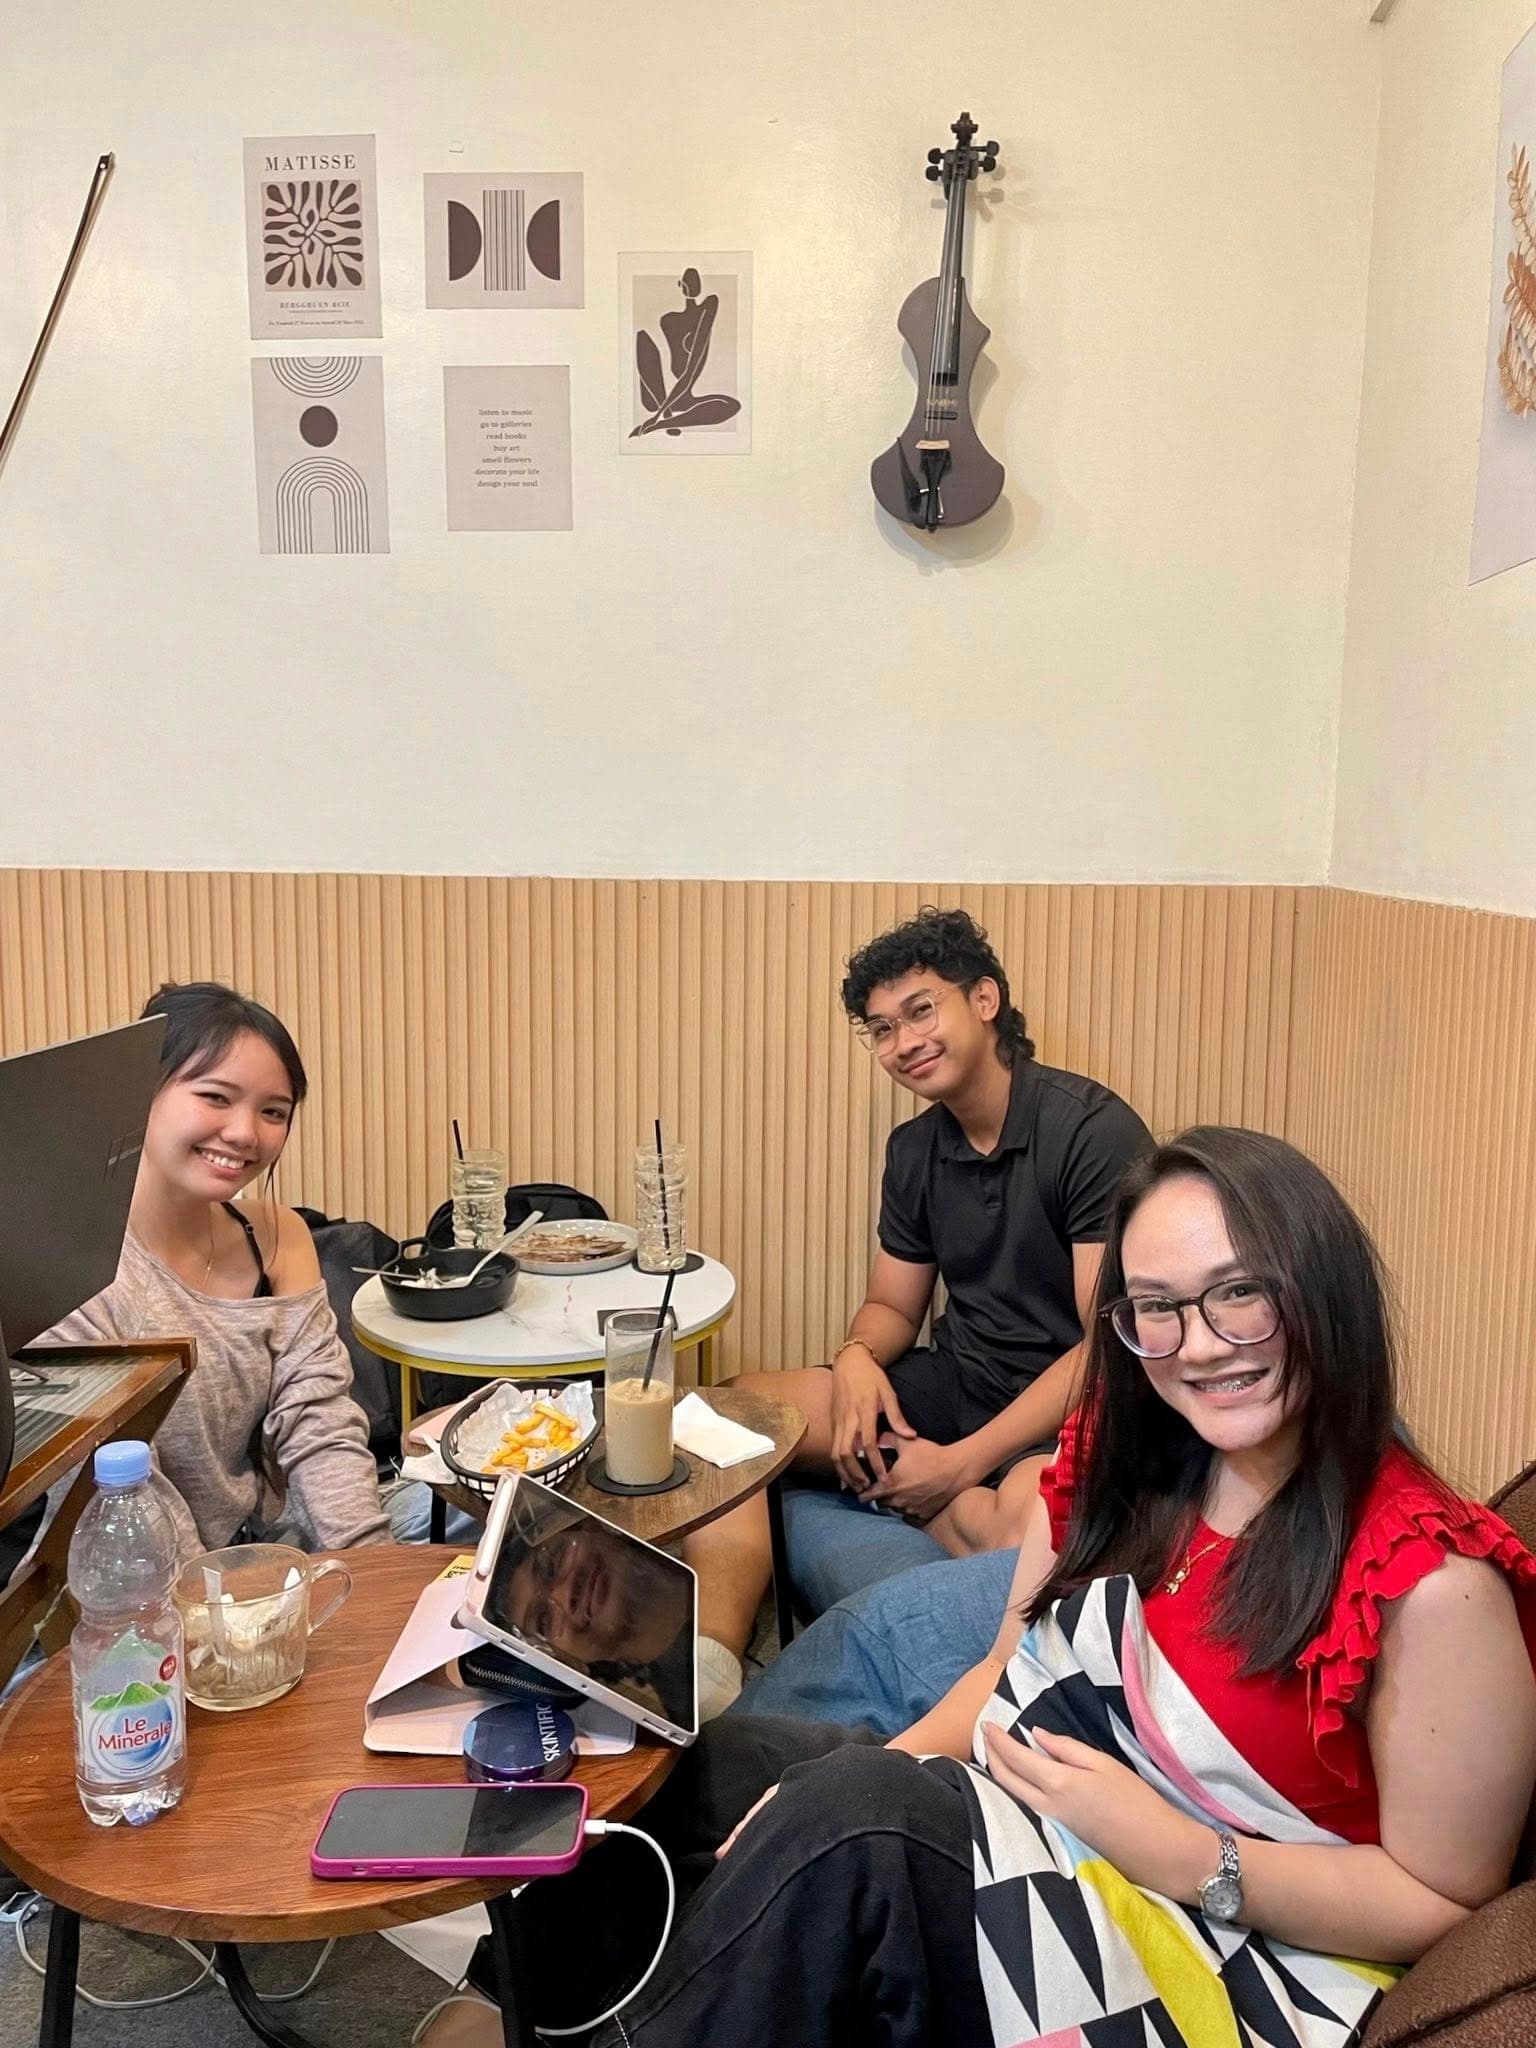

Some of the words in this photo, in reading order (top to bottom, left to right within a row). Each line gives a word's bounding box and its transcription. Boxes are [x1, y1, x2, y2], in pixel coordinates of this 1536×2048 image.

[264, 154, 356, 171] MATISSE
[478, 408, 500, 416] listen
[511, 408, 532, 416] music
[500, 420, 532, 429] galleries
[486, 432, 503, 440] read
[505, 432, 527, 440] books
[493, 444, 507, 453] buy
[508, 470, 526, 478] your
[477, 480, 501, 488] design
[124, 1717, 147, 1735] Le
[98, 1721, 172, 1750] Minerale
[535, 1702, 561, 1762] SKINTIFIC
